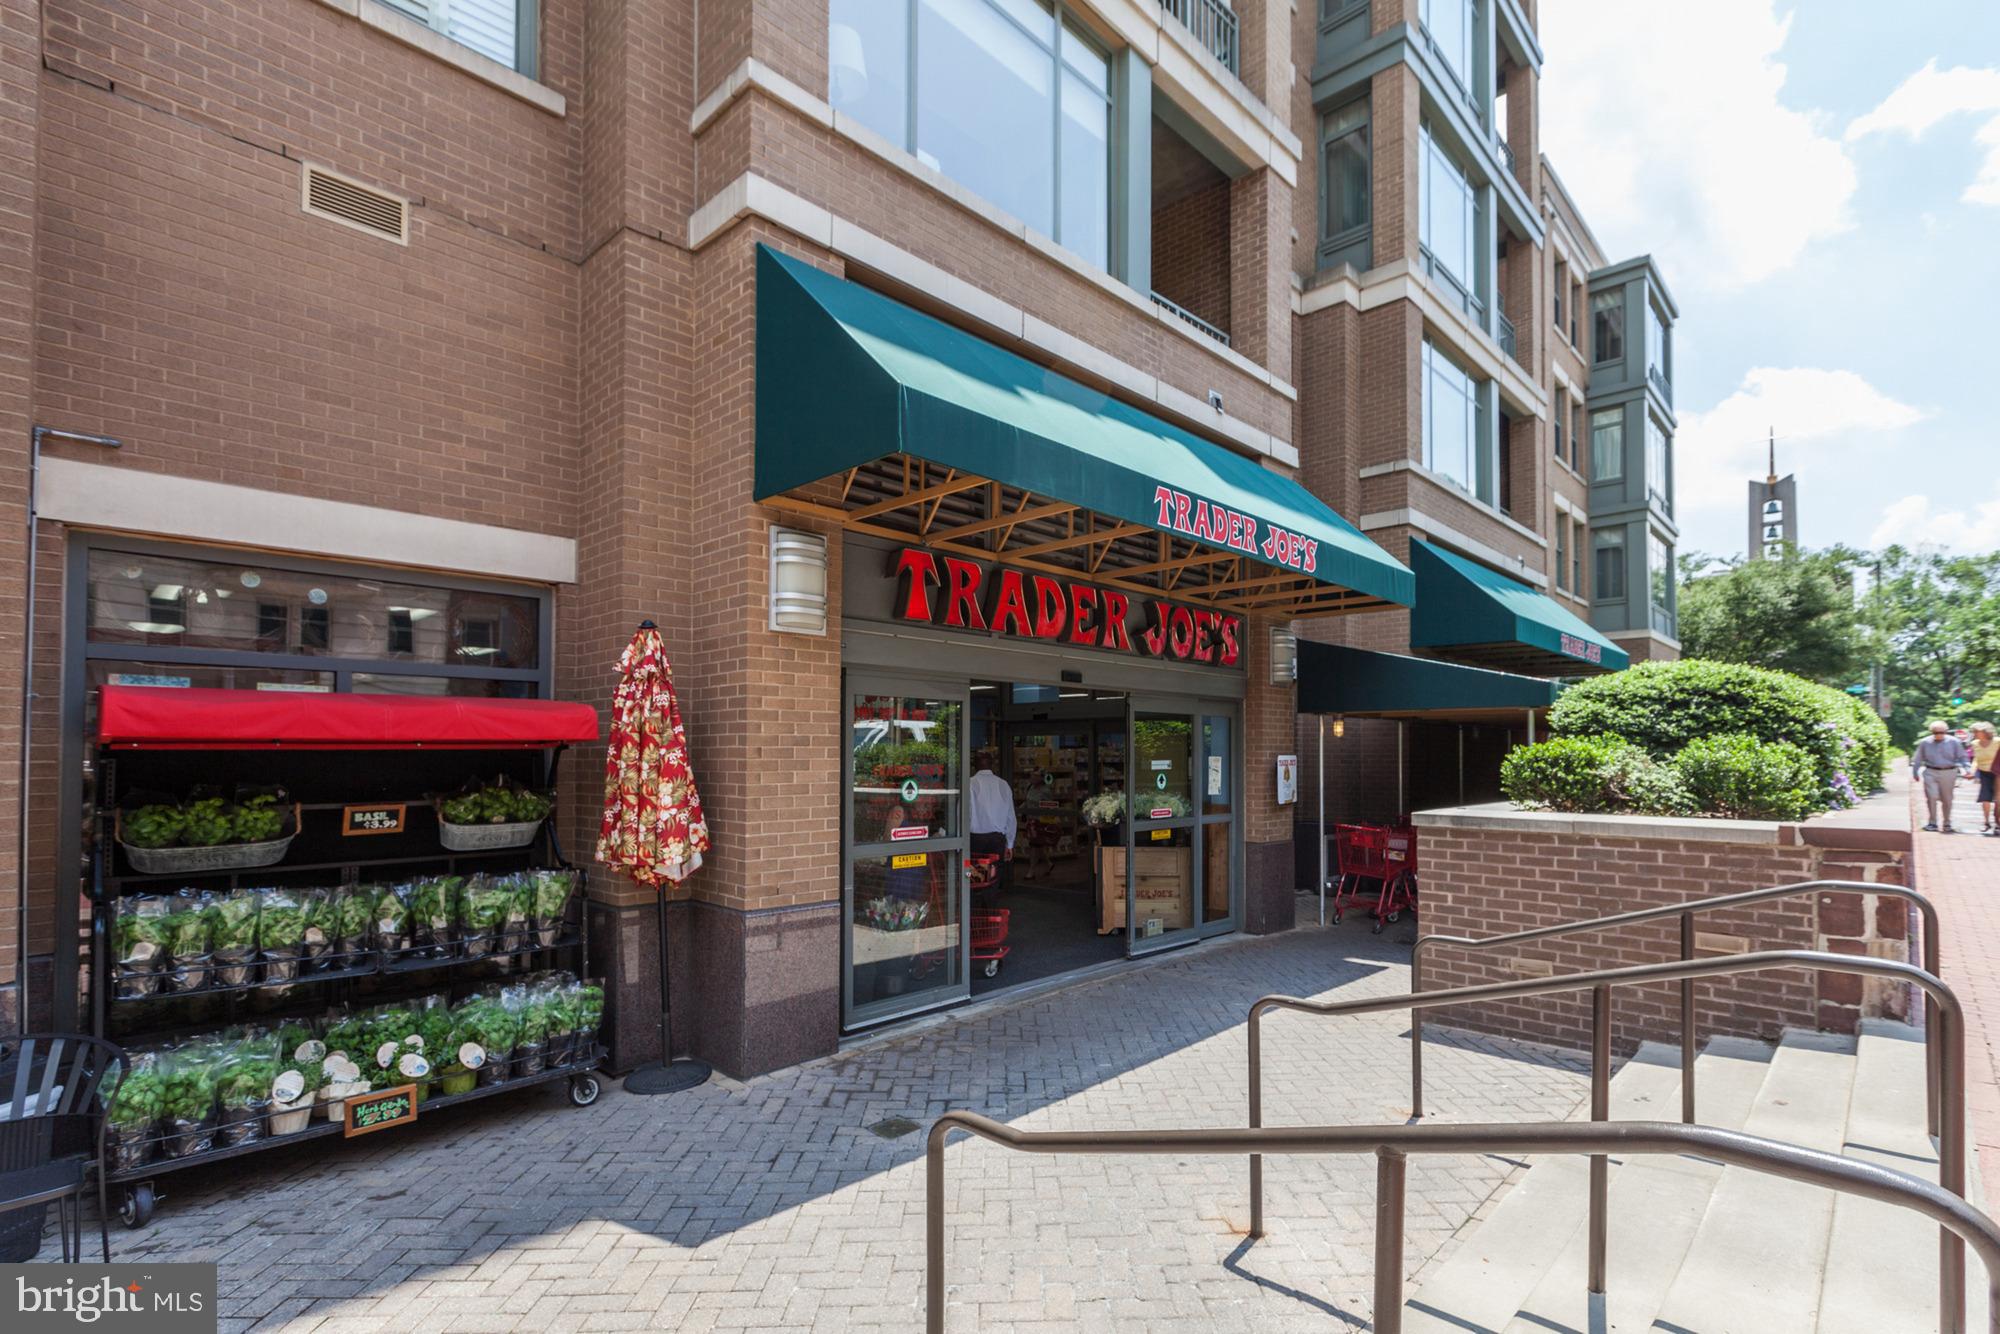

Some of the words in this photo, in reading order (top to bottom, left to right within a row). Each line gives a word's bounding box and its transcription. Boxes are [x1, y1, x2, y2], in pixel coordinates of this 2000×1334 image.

[1154, 485, 1259, 555] TRADER
[1262, 524, 1318, 573] JOE'S
[893, 548, 1132, 651] TRADER
[1142, 601, 1240, 666] JOE'S
[354, 812, 389, 822] BASIL
